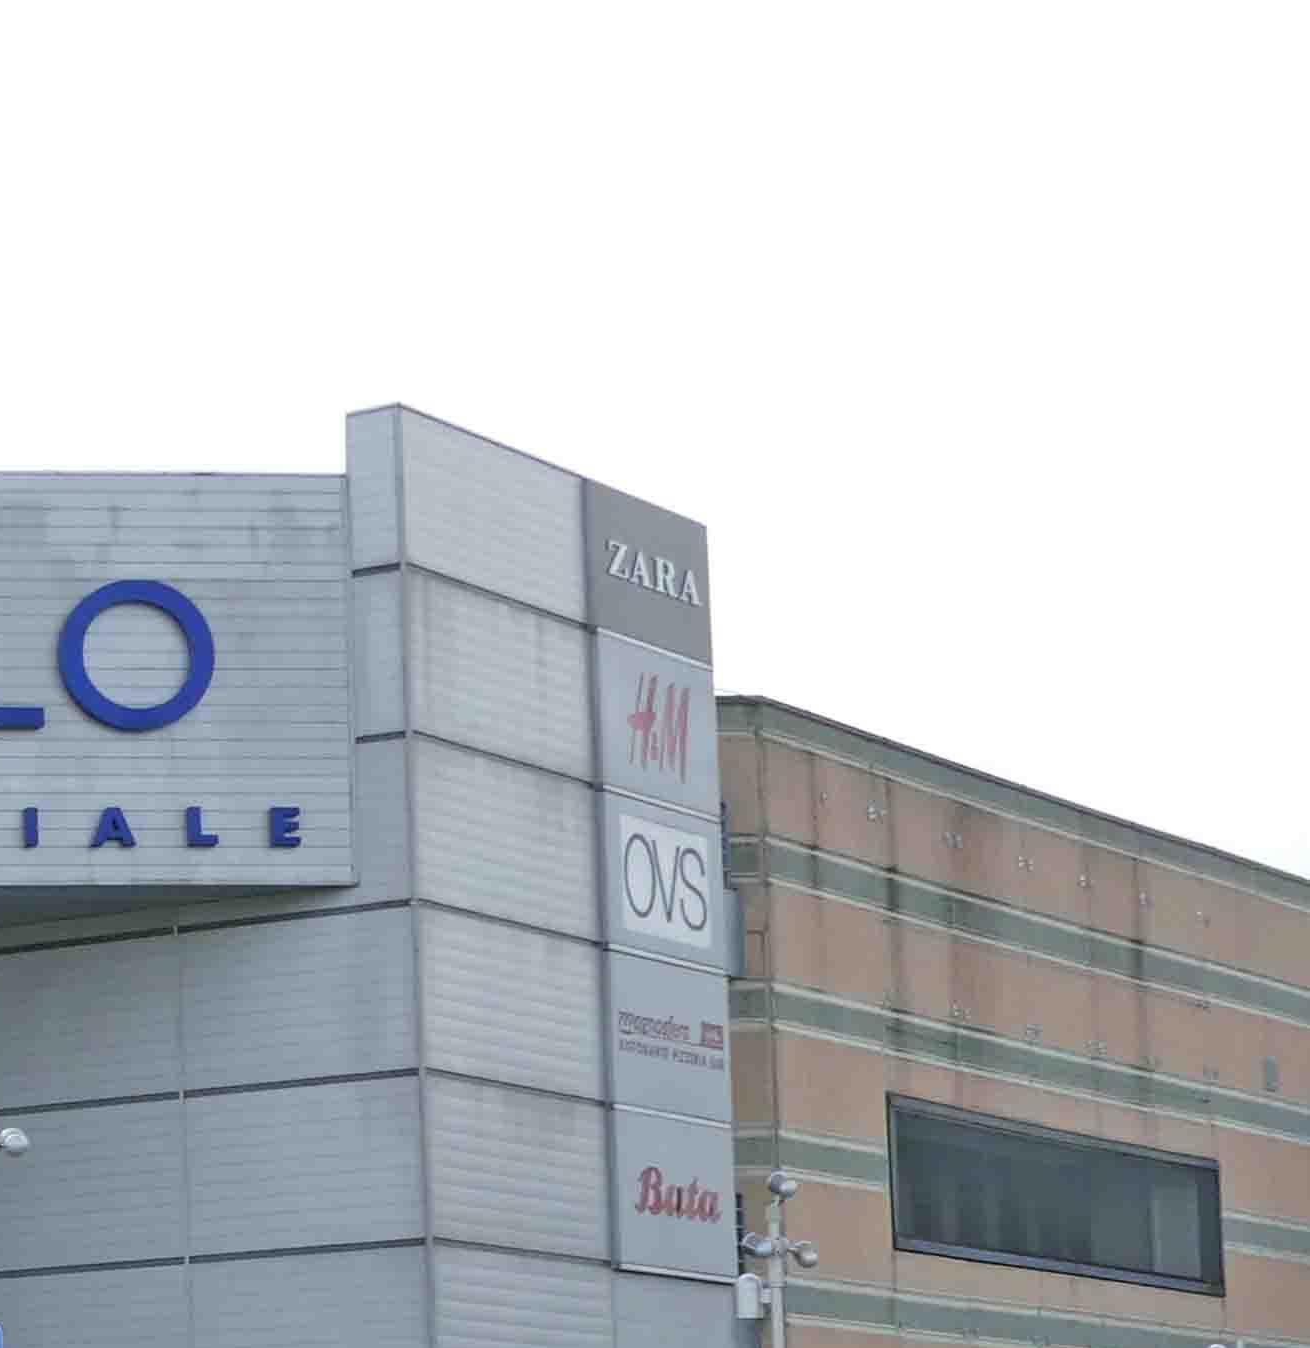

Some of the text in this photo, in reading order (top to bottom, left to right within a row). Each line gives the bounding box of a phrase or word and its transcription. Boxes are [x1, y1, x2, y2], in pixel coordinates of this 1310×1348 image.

[606, 539, 704, 607] ZARA
[624, 833, 707, 931] OVS
[635, 1166, 722, 1223] Bata
